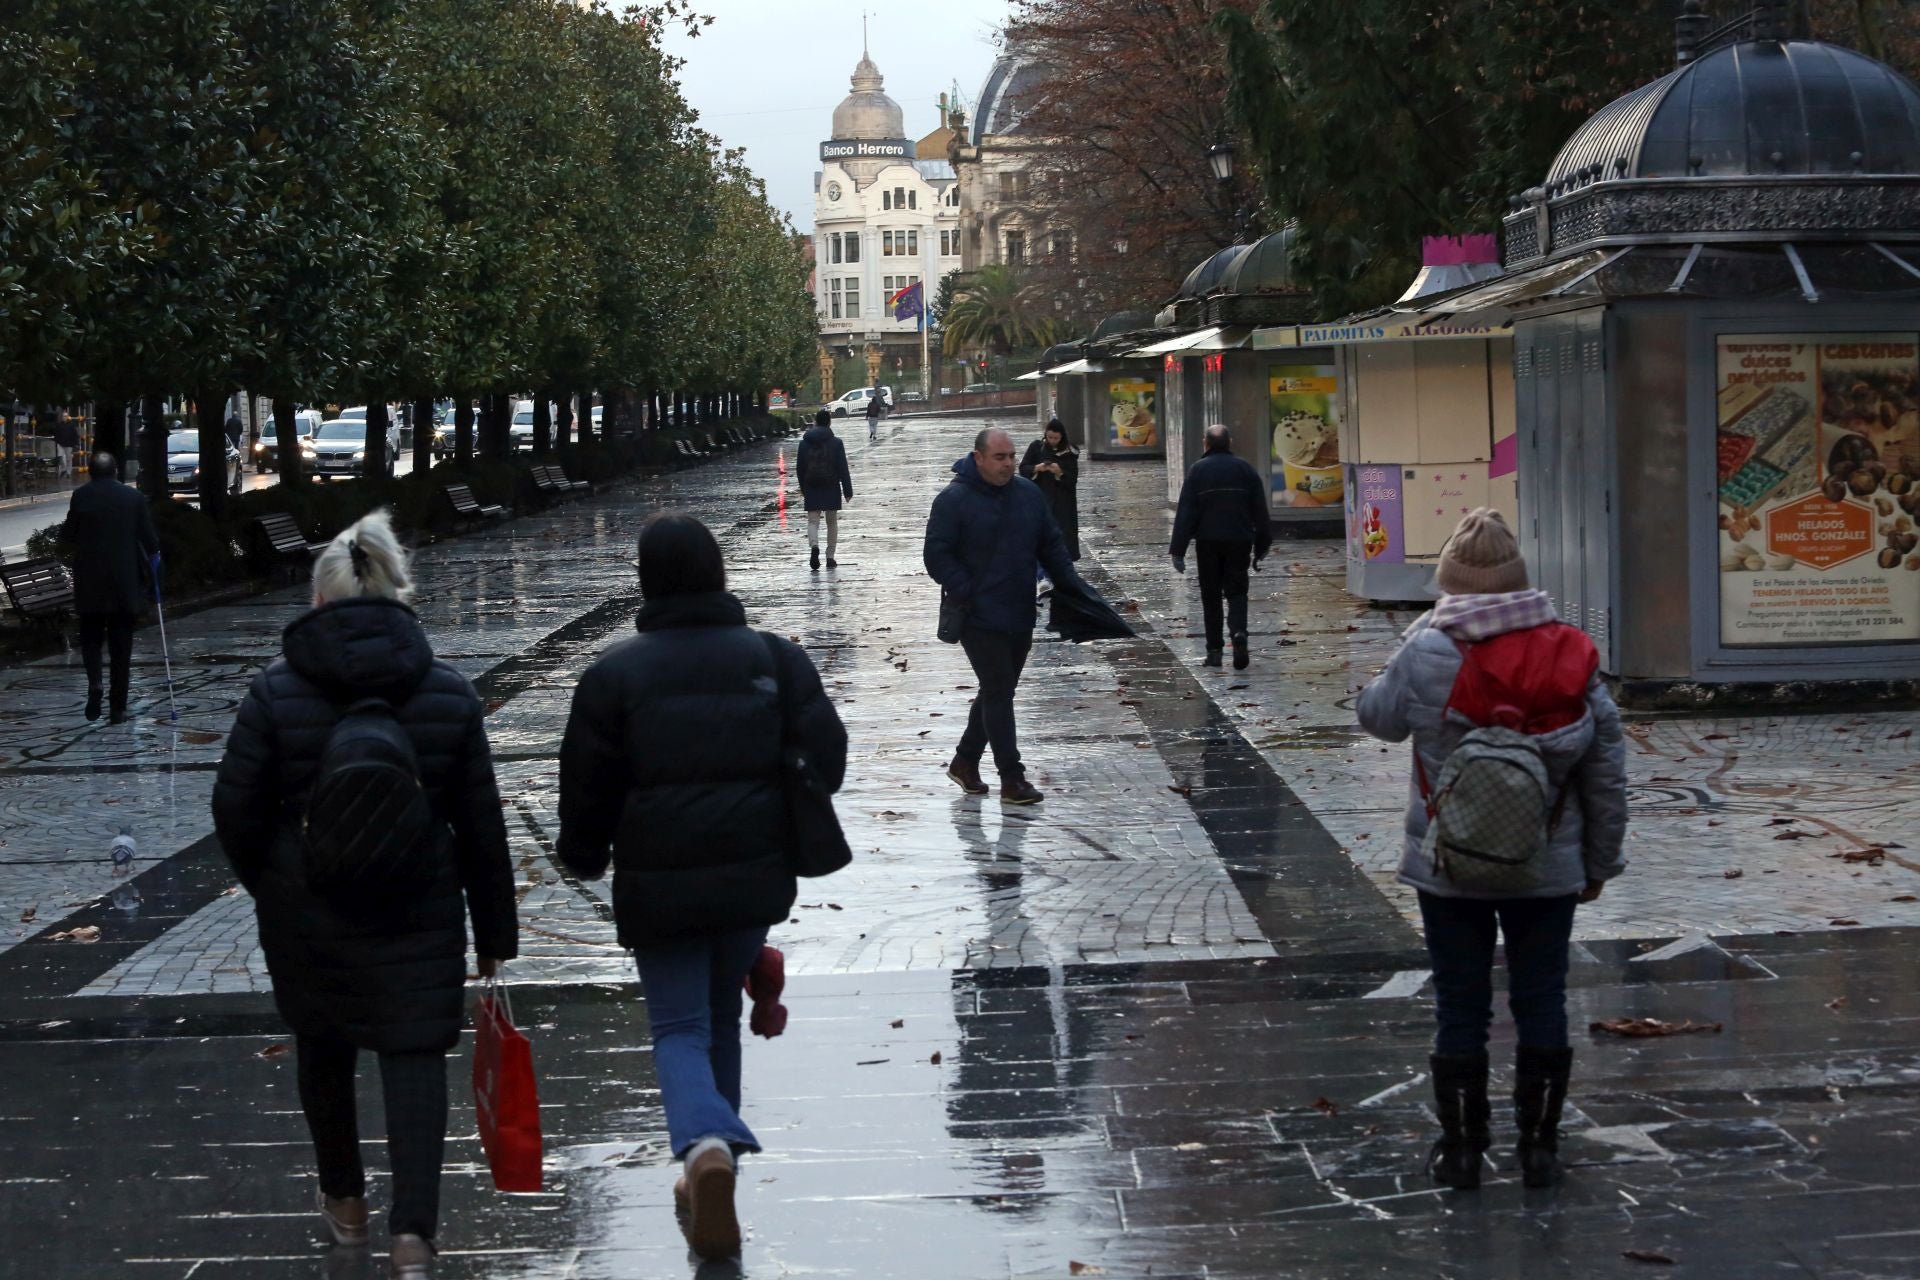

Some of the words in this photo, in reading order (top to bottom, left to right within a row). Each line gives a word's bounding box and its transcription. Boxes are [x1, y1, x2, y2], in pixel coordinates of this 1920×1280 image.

[823, 145, 855, 157] Banco
[858, 143, 904, 155] Herrero
[827, 321, 854, 329] Herrero
[1304, 327, 1385, 342] PALOMITAS
[1741, 354, 1792, 368] dulces
[1727, 369, 1807, 384] navideños
[1798, 520, 1845, 529] HELADOS
[1776, 532, 1808, 541] HNOS.
[1794, 587, 1833, 596] HELADOS
[1835, 586, 1858, 595] TODO
[1799, 598, 1837, 606] SERVICIO
[1855, 617, 1871, 626] 672
